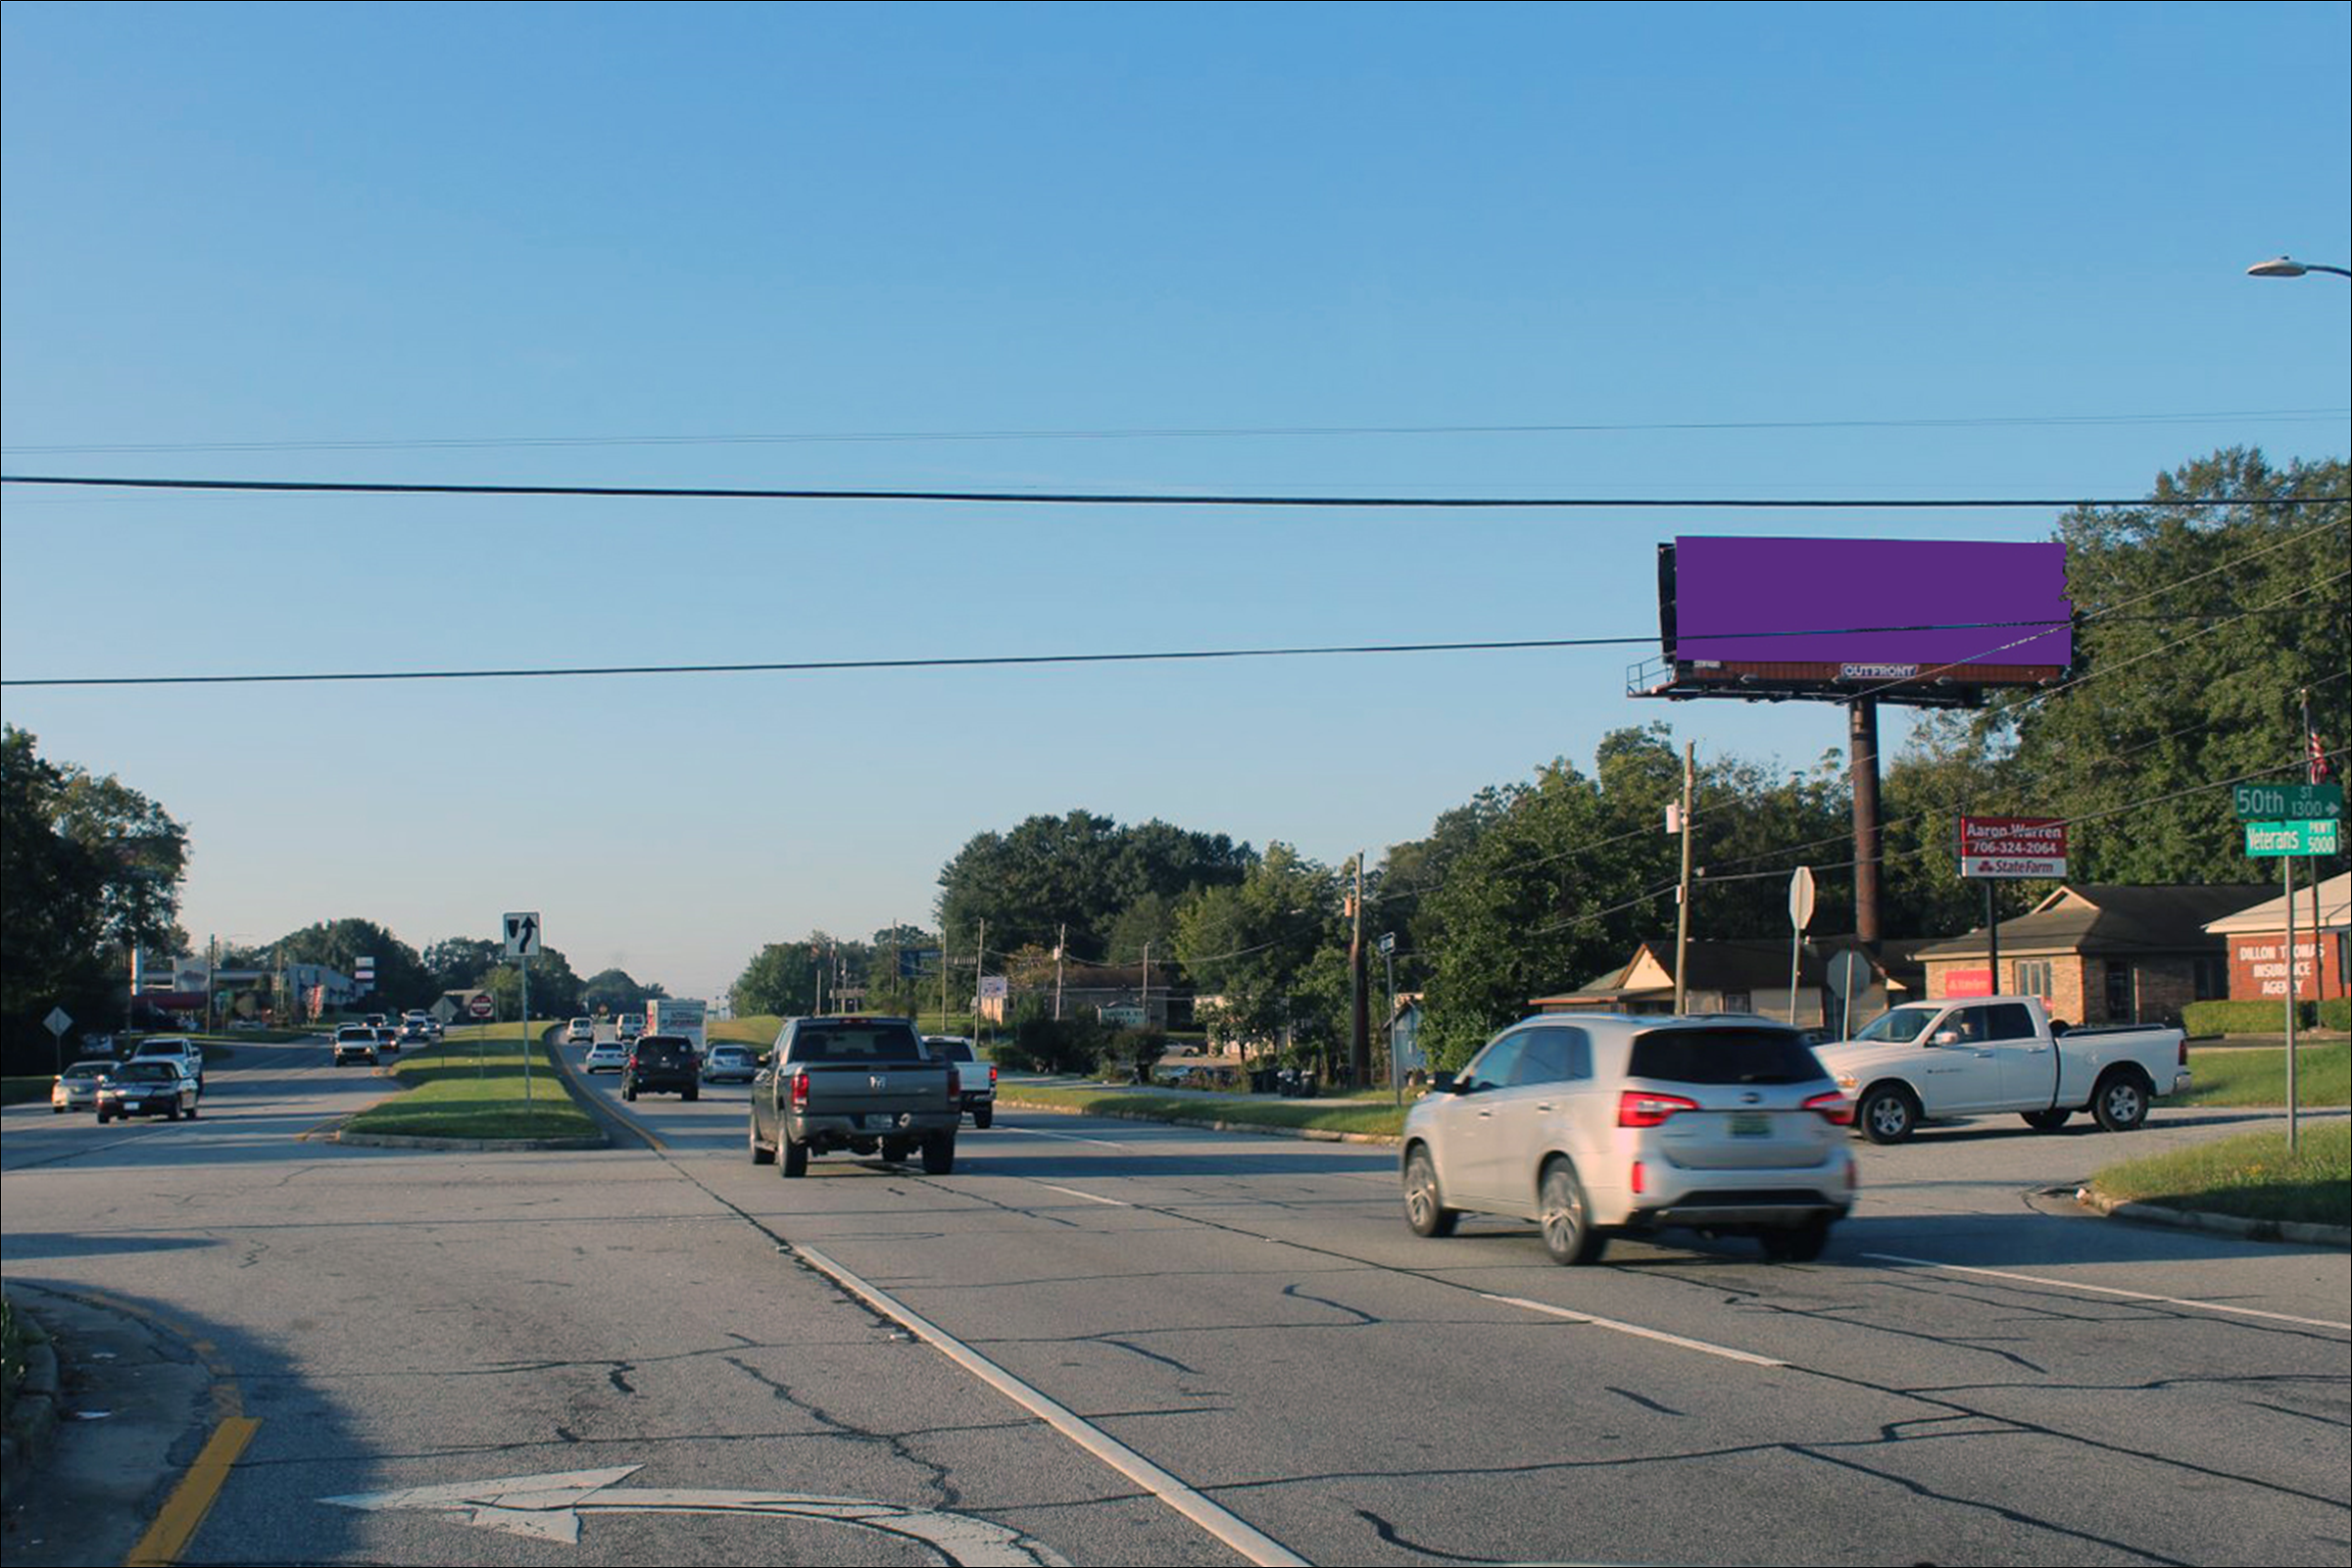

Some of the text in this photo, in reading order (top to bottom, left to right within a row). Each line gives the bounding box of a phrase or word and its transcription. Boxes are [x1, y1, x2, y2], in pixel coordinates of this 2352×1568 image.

[1843, 664, 1917, 676] OUTFRONT
[2238, 789, 2284, 813] 50th
[2291, 801, 2323, 816] 1300
[1967, 823, 2062, 839] Aaron Warren
[2246, 828, 2300, 851] Veterans
[2309, 836, 2336, 853] 5000
[1973, 842, 2057, 854] 706-324-2064
[2239, 944, 2326, 960] DILLON TOMAS
